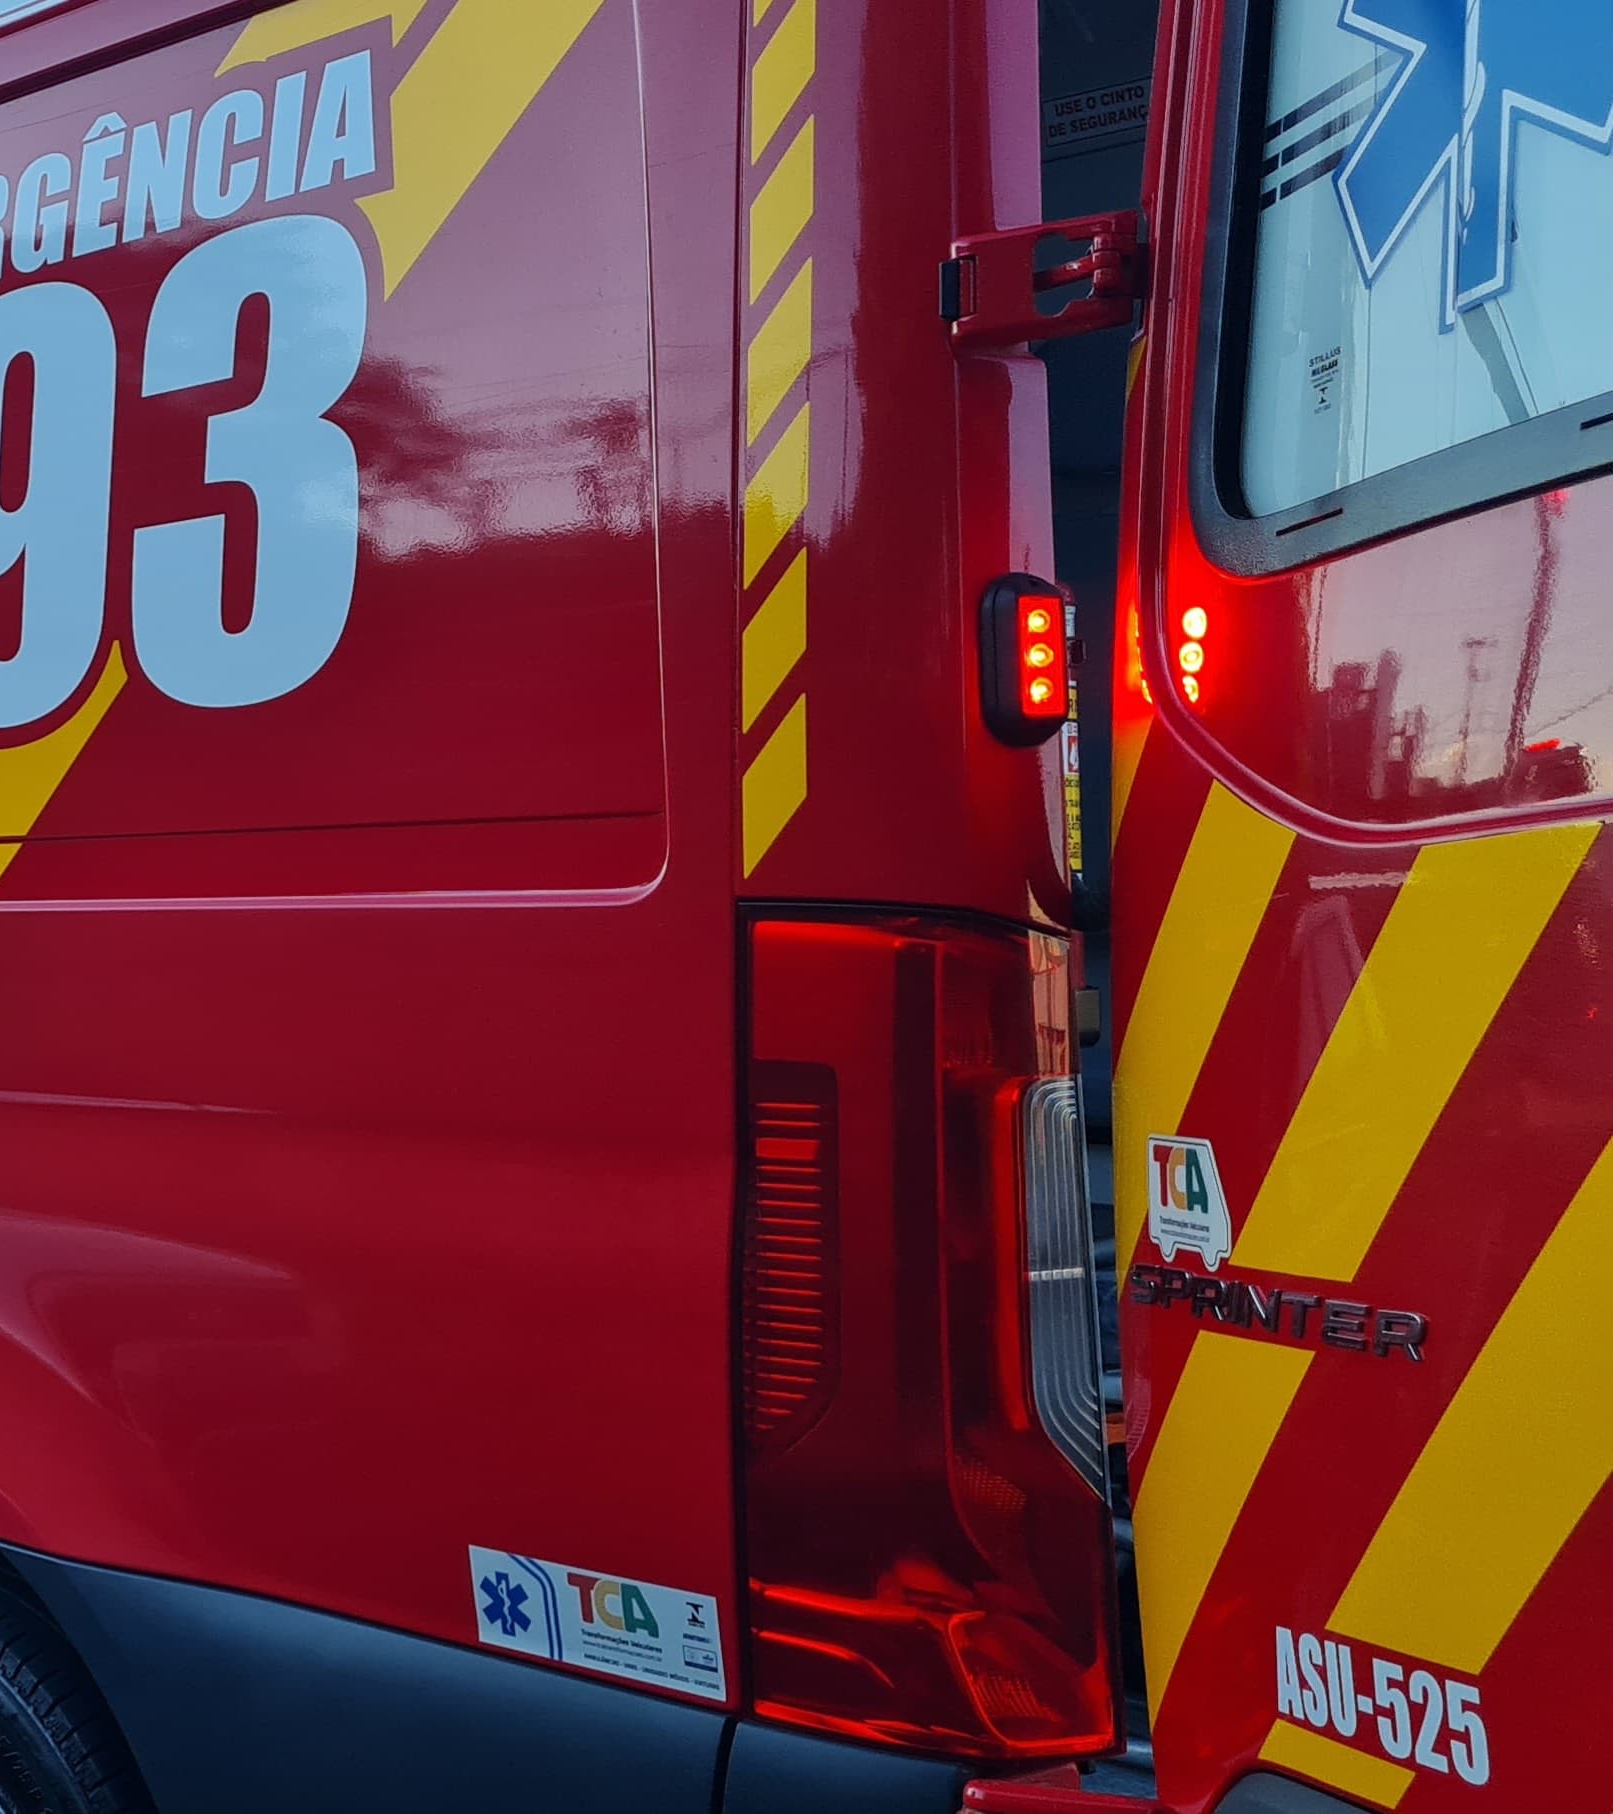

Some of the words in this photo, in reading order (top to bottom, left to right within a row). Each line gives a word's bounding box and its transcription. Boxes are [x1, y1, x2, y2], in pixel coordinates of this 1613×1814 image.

[1048, 122, 1067, 137] DE
[1069, 104, 1149, 133] SEGURANÇ
[1054, 99, 1082, 116] USE
[1086, 96, 1096, 109] O
[1100, 86, 1145, 106] CINTO
[1153, 1144, 1209, 1214] TCA
[1128, 1263, 1428, 1362] SPRINTER
[567, 1572, 660, 1639] TCA
[1275, 1626, 1490, 1786] ASU-525
